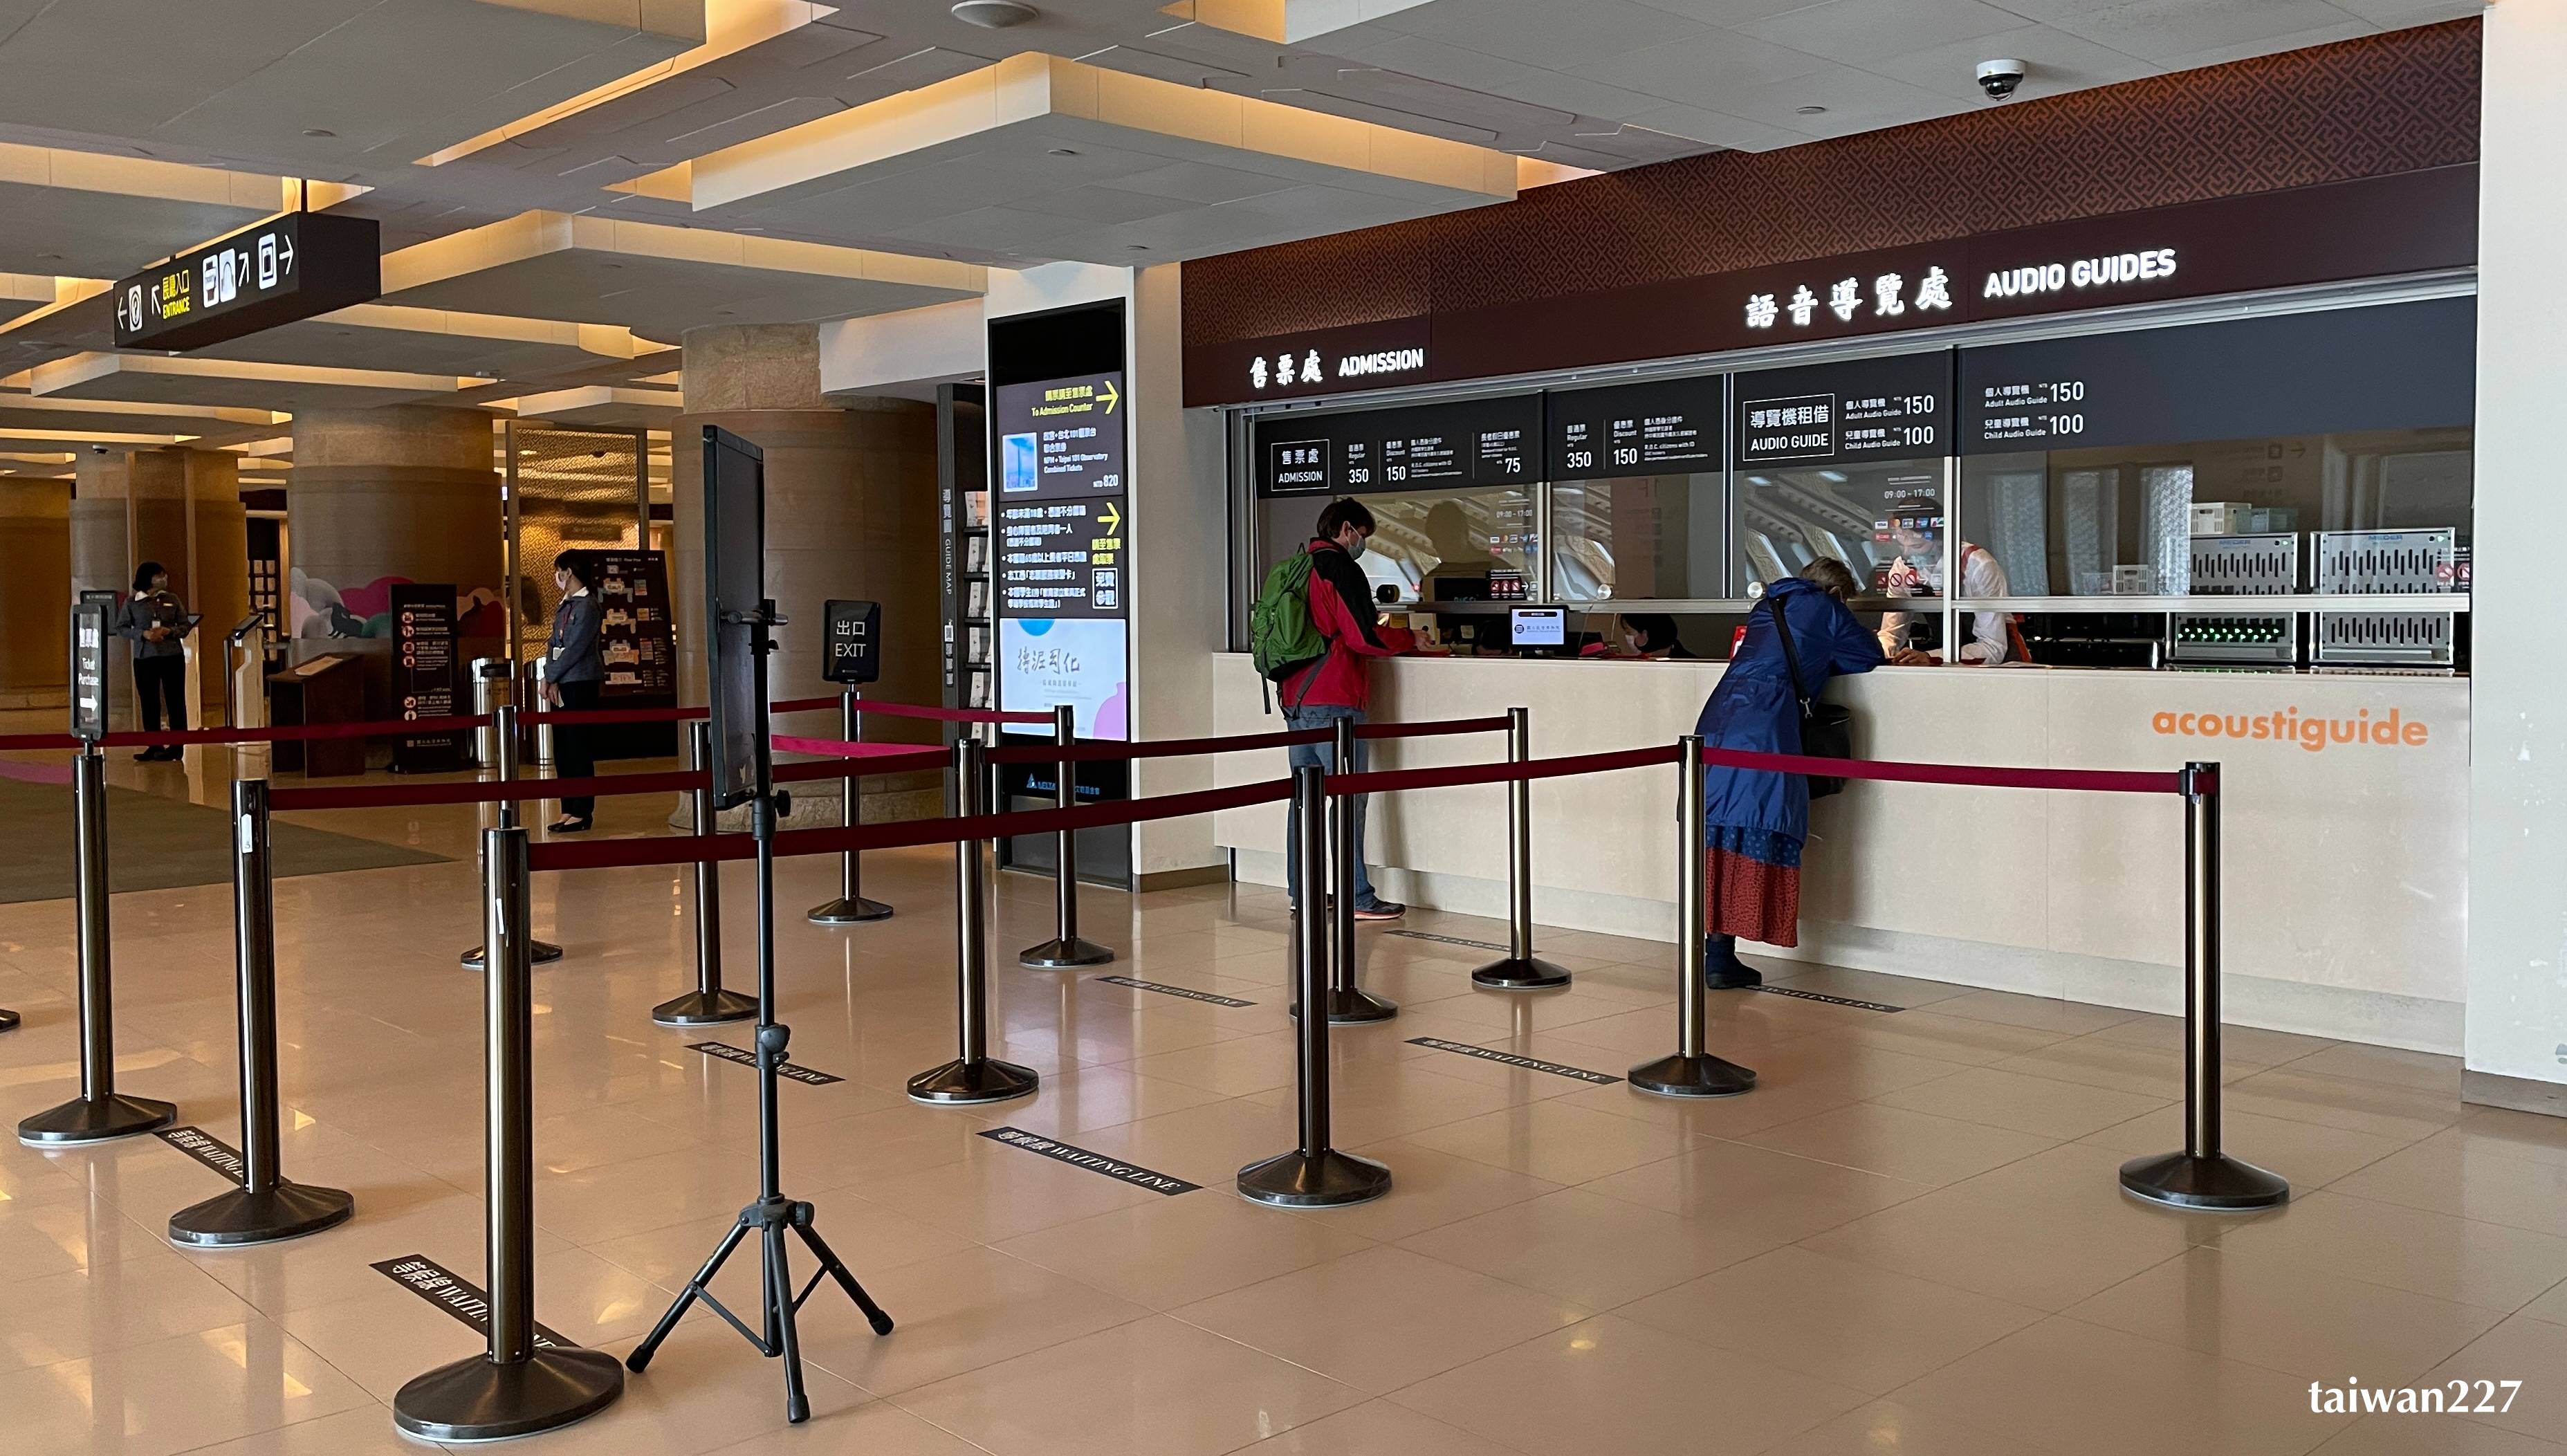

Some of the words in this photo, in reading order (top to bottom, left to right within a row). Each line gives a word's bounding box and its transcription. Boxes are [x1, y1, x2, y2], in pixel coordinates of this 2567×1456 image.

[1983, 264, 2065, 299] AUDIO
[2071, 248, 2178, 288] GUIDES
[1745, 265, 1953, 329] 語音導覽處
[163, 296, 190, 320] ENTRANCE
[1249, 349, 1323, 389] 售票處
[1338, 348, 1424, 377] ADMISSION
[2027, 396, 2048, 405] Guide
[2050, 381, 2084, 403] 150
[1031, 407, 1039, 416] To
[1040, 405, 1069, 416] Admission
[1069, 403, 1093, 412] Counter
[1904, 394, 1935, 414] 150
[1750, 404, 1829, 428] 導覽機租借
[2050, 414, 2083, 435] 100
[1751, 436, 1788, 451] AUDIO
[1791, 433, 1829, 448] GUIDE
[1904, 425, 1934, 445] 100
[2004, 430, 2024, 439] Audio
[1863, 441, 1881, 449] Audio
[1881, 439, 1901, 448] Guide
[1282, 448, 1318, 465] 售票處
[1505, 457, 1520, 474] 75
[1567, 451, 1592, 468] 350
[1613, 448, 1637, 466] 150
[1103, 474, 1119, 487] 820
[1278, 470, 1323, 483] ADMISSION
[1349, 468, 1369, 483] 350
[1386, 466, 1406, 481] 150
[1884, 490, 1906, 499] 09:00
[1913, 488, 1935, 498] 17:00
[836, 620, 865, 636] 出口
[835, 643, 866, 657] EXIT
[2152, 706, 2429, 753] acoustiguide
[1049, 1146, 1132, 1174] WAITING
[1128, 1172, 1181, 1190] LINE
[392, 1261, 453, 1291] 等候線
